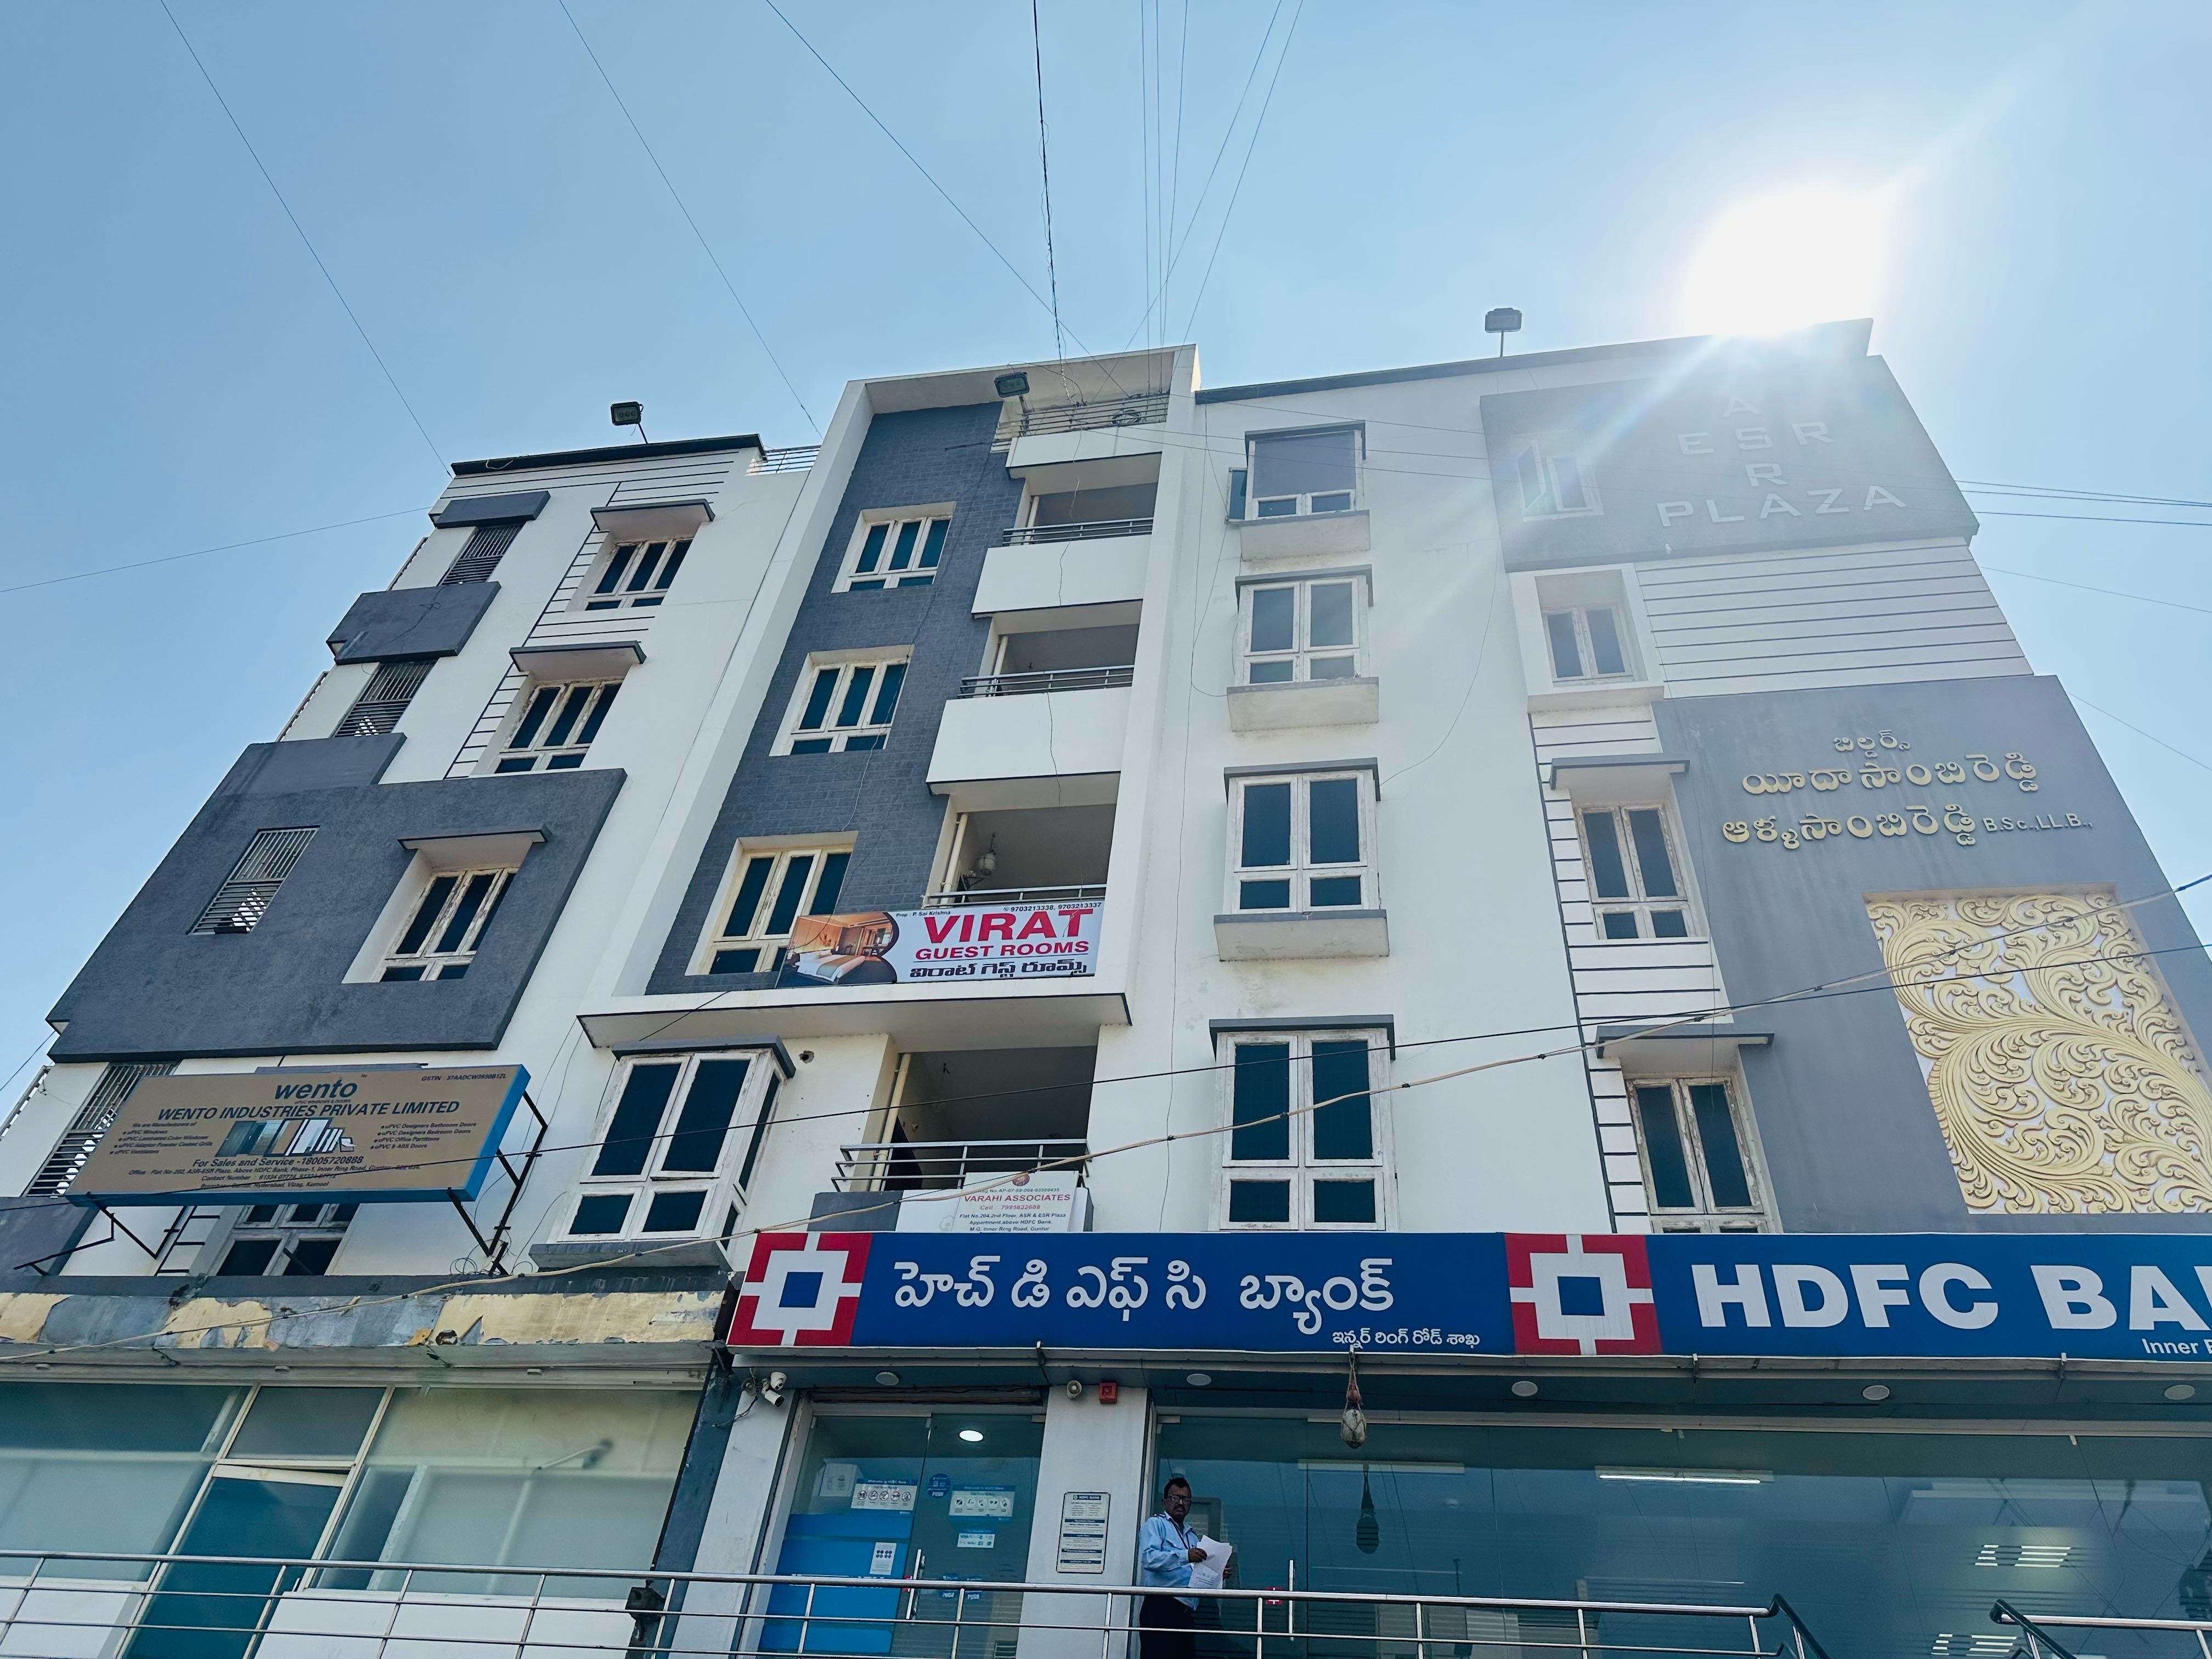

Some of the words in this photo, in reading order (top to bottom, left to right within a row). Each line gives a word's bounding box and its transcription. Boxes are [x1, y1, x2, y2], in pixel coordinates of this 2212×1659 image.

[1722, 396, 1760, 417] A
[1745, 463, 1788, 486] R
[1656, 486, 1908, 526] PLAZA
[1833, 729, 1911, 758] బిల్డర్స్
[924, 909, 1093, 944] VIRAT
[916, 947, 989, 960] GUEST
[1000, 941, 1090, 956] ROOMS
[910, 963, 977, 978] విరాట్
[275, 1076, 358, 1099] wento
[158, 1107, 218, 1120] WENTO
[219, 1105, 317, 1119] INDUSTRIES
[320, 1103, 390, 1116] PRIVATE
[392, 1101, 460, 1114] LIMITED
[258, 1157, 294, 1166] Service
[894, 1255, 1001, 1307] హెచ్
[1011, 1259, 1050, 1308] డి
[1066, 1256, 1148, 1322] ఎఫ్
[1165, 1260, 1206, 1310] సి
[1239, 1258, 1394, 1335] బ్యాంక్
[1691, 1262, 1999, 1330] HDFC
[2030, 1265, 2212, 1330] BA
[1332, 1328, 1371, 1349] ఇన్నర్
[1375, 1328, 1408, 1344] రింగ్
[1412, 1328, 1443, 1345] రోడ్
[1446, 1333, 1480, 1348] శాఖ
[2141, 1339, 2198, 1355] Inner
